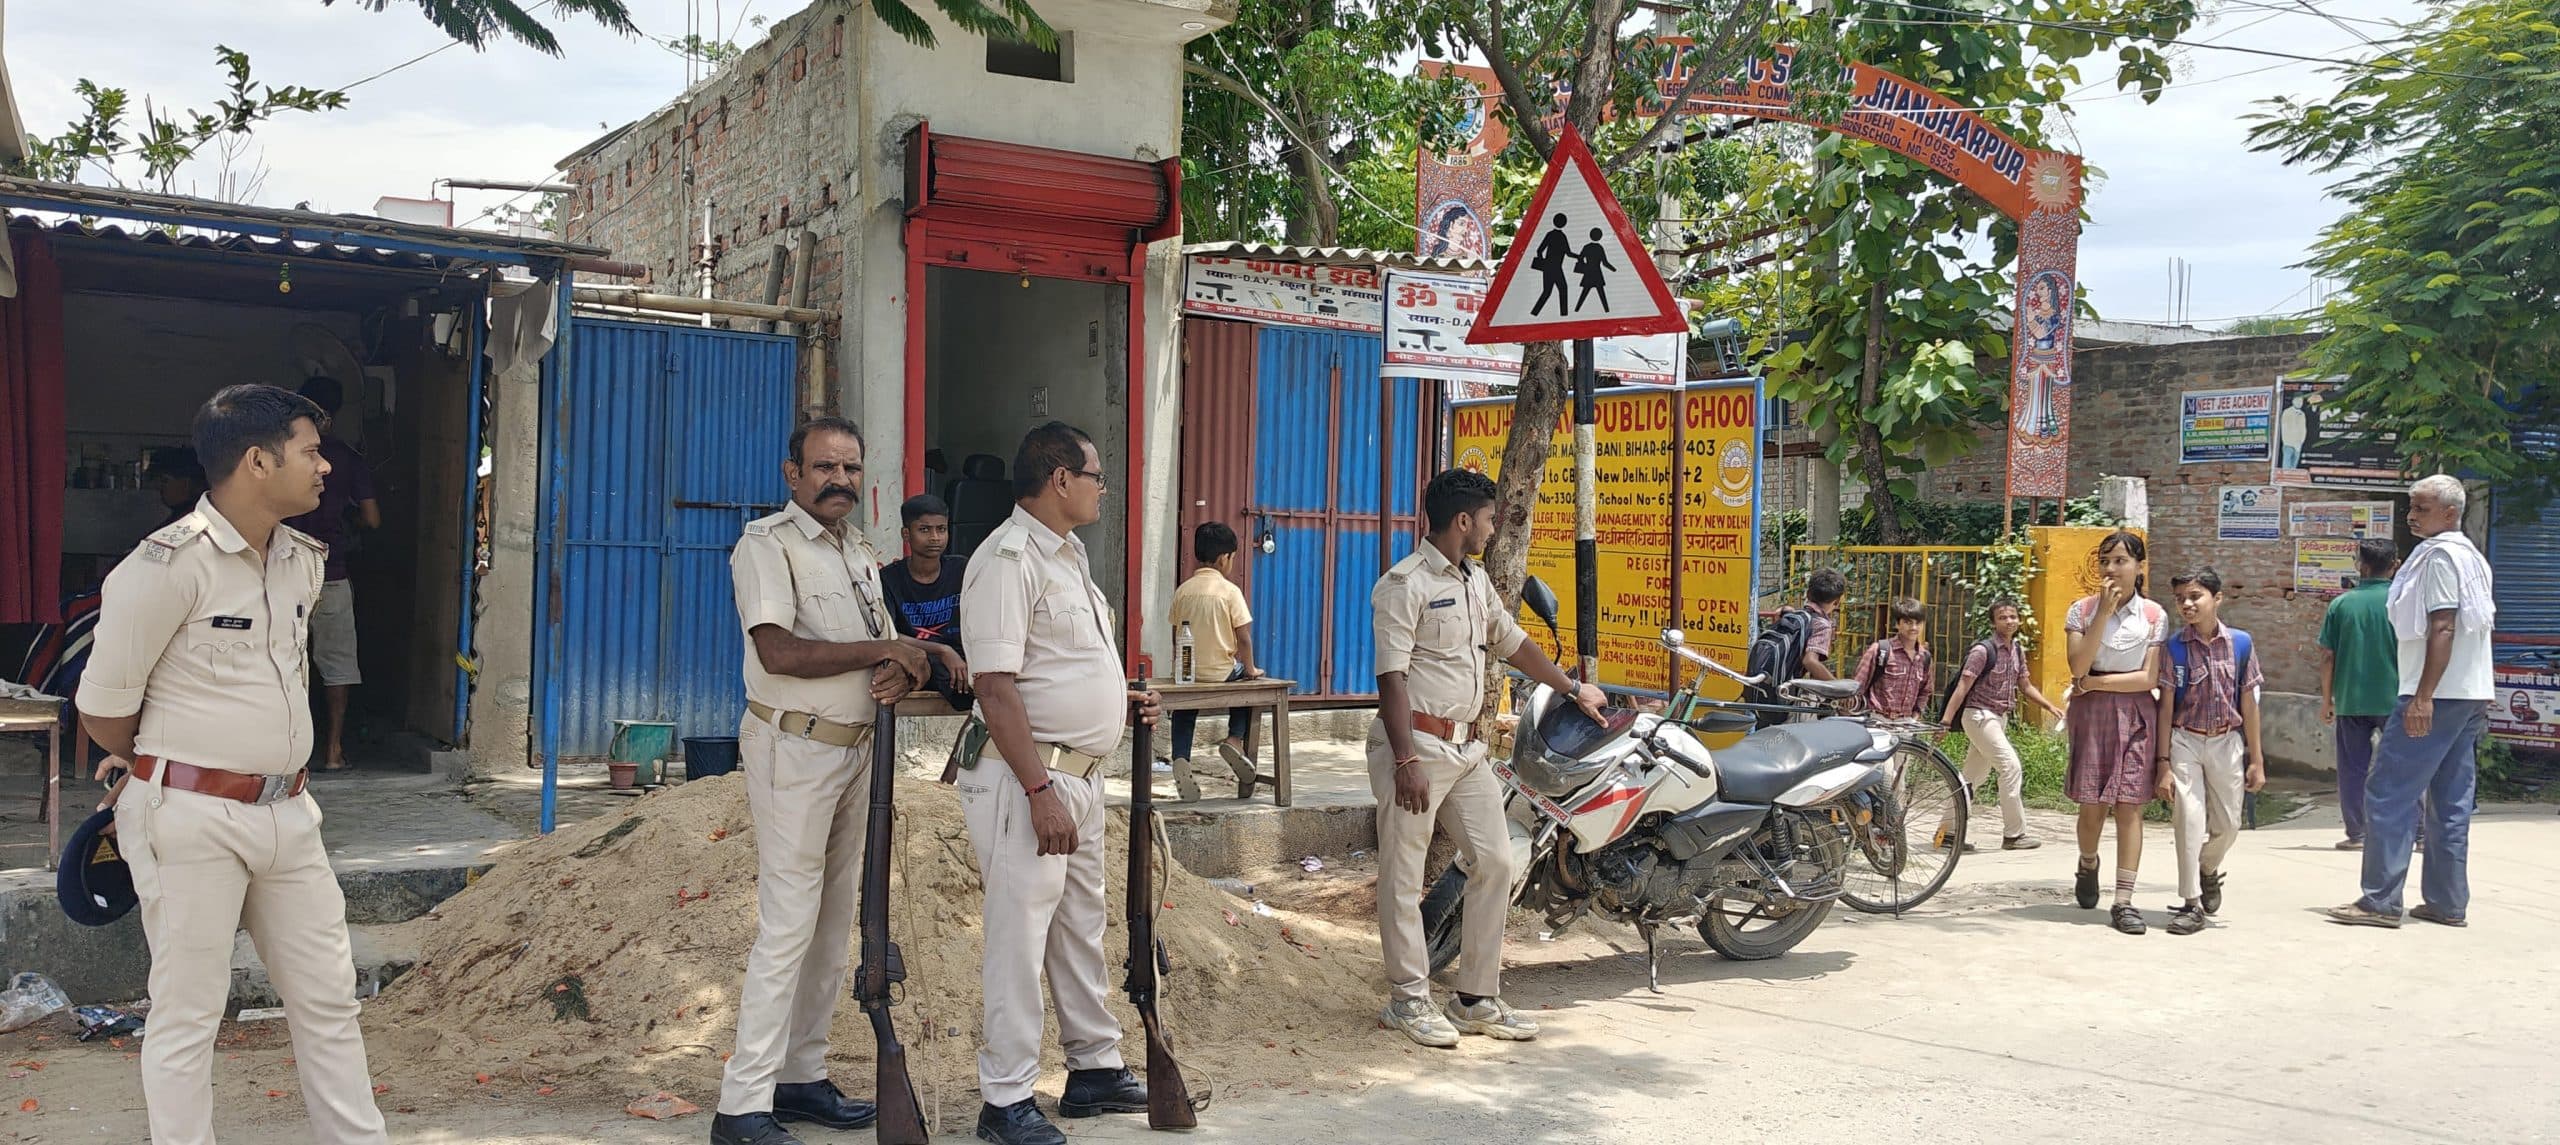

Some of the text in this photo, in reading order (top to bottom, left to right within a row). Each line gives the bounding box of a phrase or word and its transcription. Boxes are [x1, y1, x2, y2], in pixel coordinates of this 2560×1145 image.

[1863, 77, 2027, 186] JHANJHARPUR
[2196, 393, 2269, 411] NEET JEE ACADEMY
[1459, 410, 1514, 437] M.N.JH
[1594, 398, 1668, 432] PUBLIC
[1685, 393, 1755, 430] CHOOL
[1626, 439, 1716, 458] BIHAR-84403
[1594, 467, 1619, 483] New
[1652, 466, 1671, 489] Upt
[1595, 513, 1657, 527] MANAGEMENT
[1705, 514, 1725, 529] NEW
[1727, 514, 1750, 530] DELHI
[1626, 557, 1728, 575] REGISTATION
[1646, 576, 1671, 591] FOR
[1616, 592, 1740, 614] ADMISSIO OPEN
[1708, 614, 1743, 635] Seats
